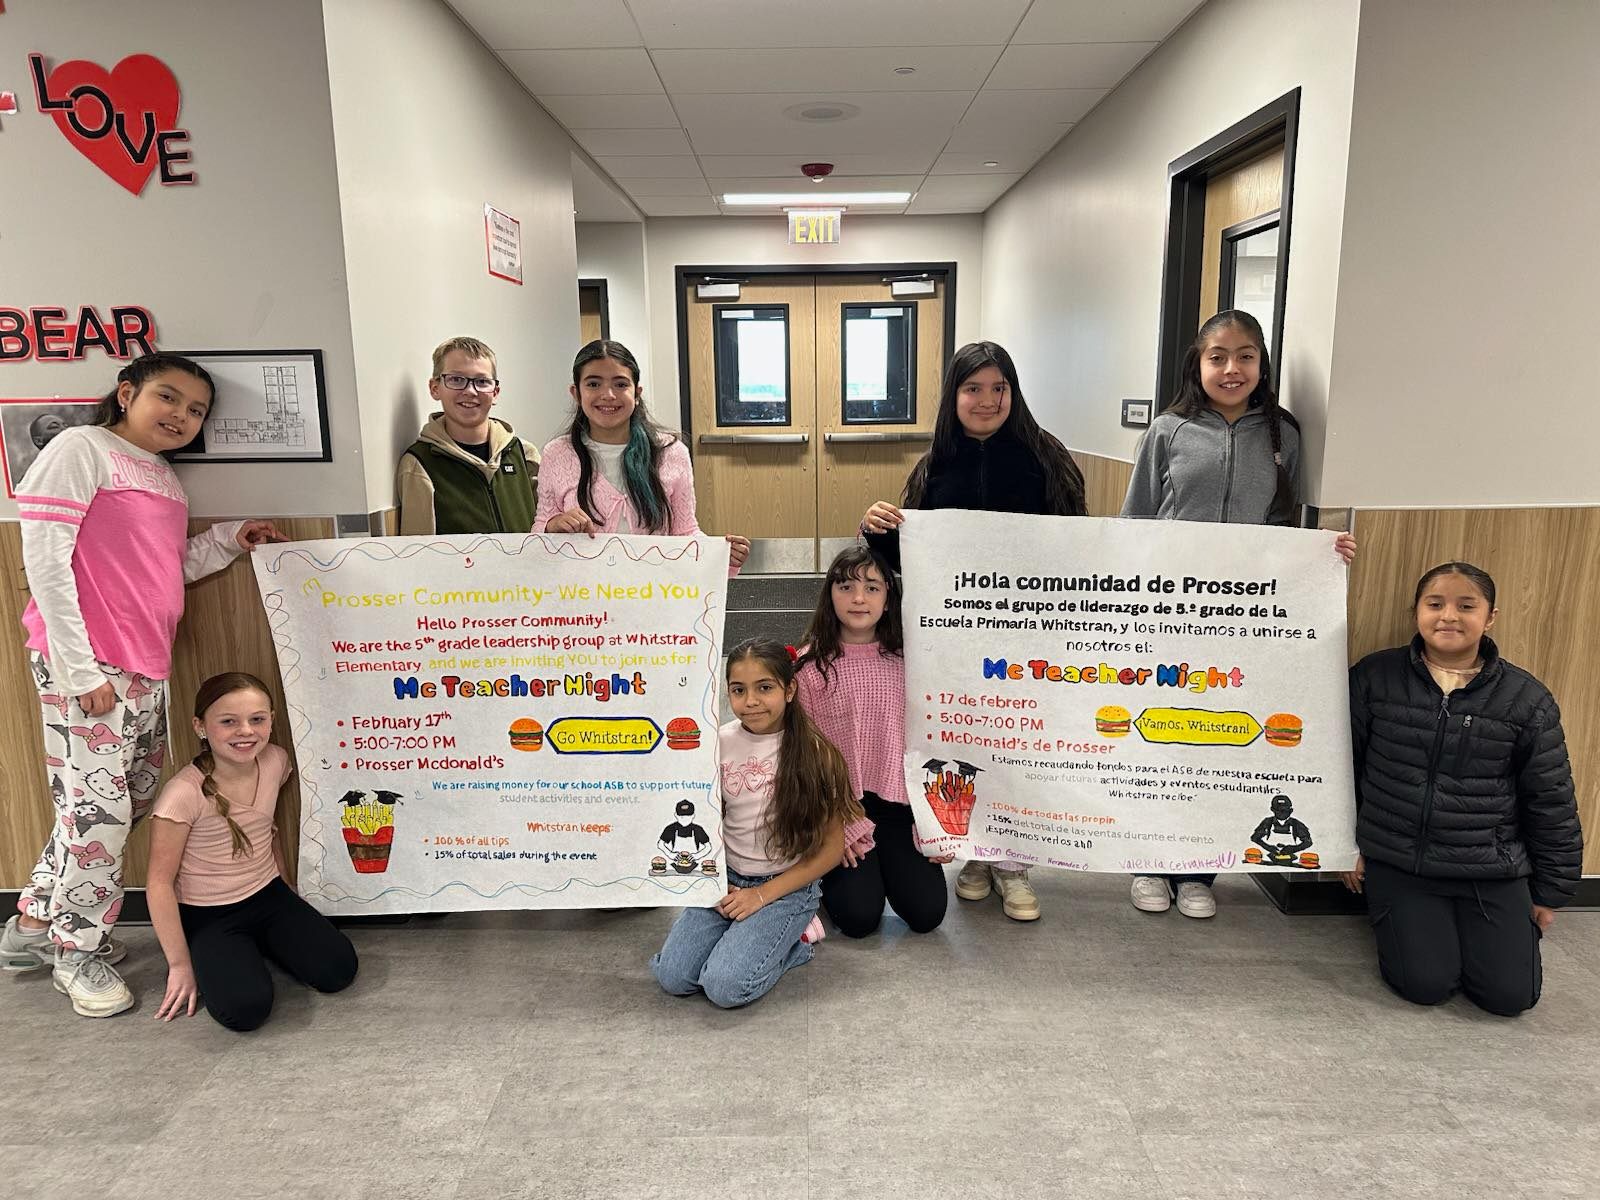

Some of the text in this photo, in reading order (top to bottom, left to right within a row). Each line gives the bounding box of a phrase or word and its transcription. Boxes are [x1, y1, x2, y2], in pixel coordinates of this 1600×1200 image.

[29, 54, 194, 184] LOVE
[795, 216, 834, 243] EXIT
[0, 307, 155, 360] BEAR
[954, 571, 1277, 596] ¡Hola comunidad de Prosser!
[321, 590, 405, 608] Prosser
[558, 583, 590, 600] We
[596, 581, 653, 600] Need
[659, 583, 699, 600] You
[944, 598, 992, 610] Somos
[995, 598, 1009, 610] el
[1012, 600, 1054, 614] grupo
[1058, 600, 1077, 612] de
[1080, 600, 1149, 616] liderazgo
[1153, 602, 1172, 615] de
[1199, 604, 1245, 618] grado
[1249, 605, 1268, 617] de
[1273, 605, 1288, 618] la
[416, 611, 608, 630] Hello Prosser Community!
[920, 615, 973, 628] Escuela
[1041, 618, 1117, 634] Whitstran,
[1120, 623, 1129, 635] y
[1134, 622, 1155, 634] los
[1159, 622, 1235, 637] invitamos
[1239, 628, 1247, 637] a
[1252, 626, 1302, 639] unirse
[1307, 628, 1317, 640] a
[331, 634, 698, 653] We are the 5th grade leadership group at Whitstran
[1066, 640, 1153, 654] nosotros el:
[336, 660, 422, 673] Elementary
[429, 656, 456, 670] and
[460, 659, 480, 669] we
[484, 657, 506, 668] are
[512, 653, 564, 669] inviting
[569, 654, 598, 666] YOU
[602, 654, 616, 665] to
[619, 653, 648, 669] join
[651, 655, 667, 665] us
[564, 671, 647, 702] Night
[1157, 662, 1245, 693] Night
[938, 693, 1038, 709] 17 de febrero
[352, 711, 452, 731] February 17th
[940, 712, 1044, 731] 5:00-7:00 PM
[1187, 719, 1250, 734] Whitstran!
[354, 735, 457, 750] 5:00-7:00 PM
[556, 730, 652, 745] Go Whitstran!
[1033, 739, 1051, 751] de
[1057, 740, 1116, 754] Prosser
[355, 755, 505, 771] Prosser Mcdonald's
[992, 754, 1033, 767] Estamos
[1034, 759, 1094, 770] recaudando
[1135, 765, 1158, 774] para
[1160, 765, 1169, 774] el
[1172, 765, 1193, 775] ASB
[1196, 767, 1210, 776] de
[1212, 769, 1252, 780] nuestra
[1255, 772, 1295, 781] escuela
[1297, 775, 1323, 784] para
[432, 779, 712, 792] We are raising money for our school ASB to support future
[1025, 771, 1059, 783] apoyar
[1062, 773, 1097, 784] futuras
[1100, 776, 1158, 787] actividades
[1160, 779, 1166, 788] y
[1170, 780, 1211, 790] eventos
[500, 793, 538, 803] student
[540, 793, 583, 803] activities
[584, 794, 602, 804] and
[1108, 789, 1158, 801] Whitstran
[992, 802, 1018, 814] 100%
[1021, 807, 1033, 816] de
[1064, 812, 1080, 821] las
[527, 821, 580, 832] Whitstran
[985, 824, 1039, 841] ¡Esperamos
[992, 814, 1214, 844] 15% del total de las ventas durante el evento
[466, 836, 476, 844] of
[477, 837, 491, 846] all
[491, 837, 510, 847] tips
[434, 849, 597, 863] 15% of total sales during the event
